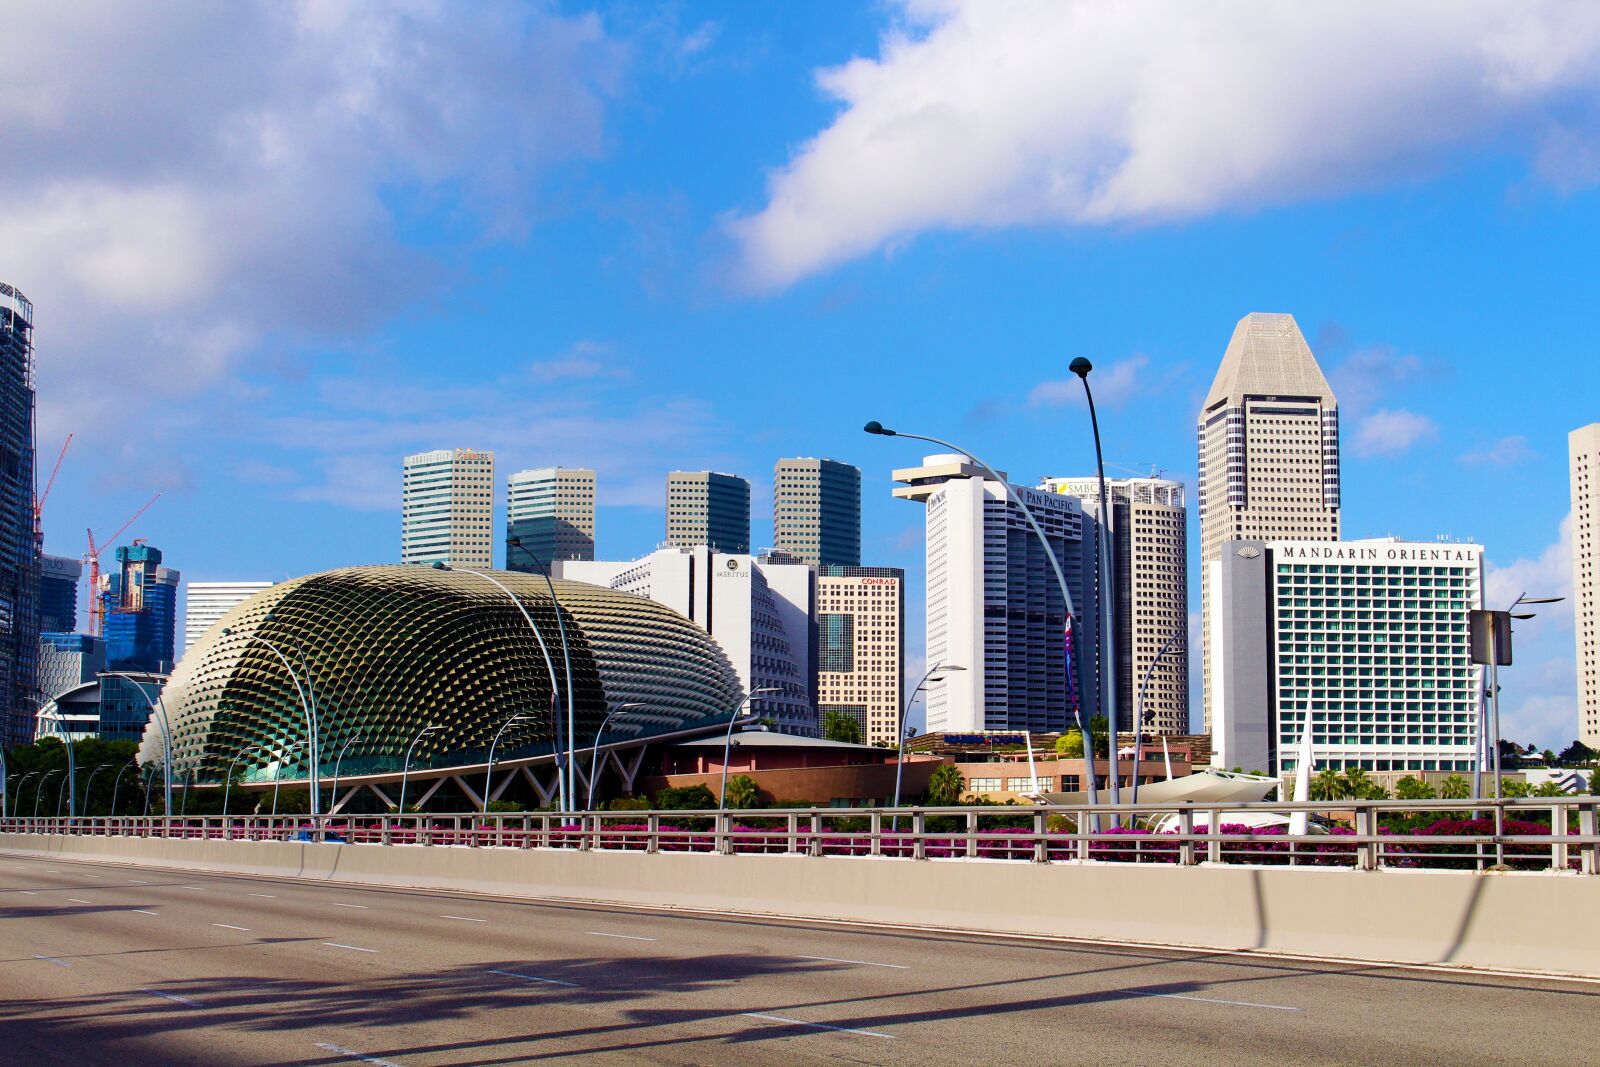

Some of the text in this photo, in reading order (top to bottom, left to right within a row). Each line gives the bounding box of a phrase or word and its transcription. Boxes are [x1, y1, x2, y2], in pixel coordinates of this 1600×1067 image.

[1068, 484, 1098, 493] SMBC
[1026, 491, 1073, 511] PAN PACIFIC
[1284, 547, 1474, 560] MANDARIN ORIENTAL
